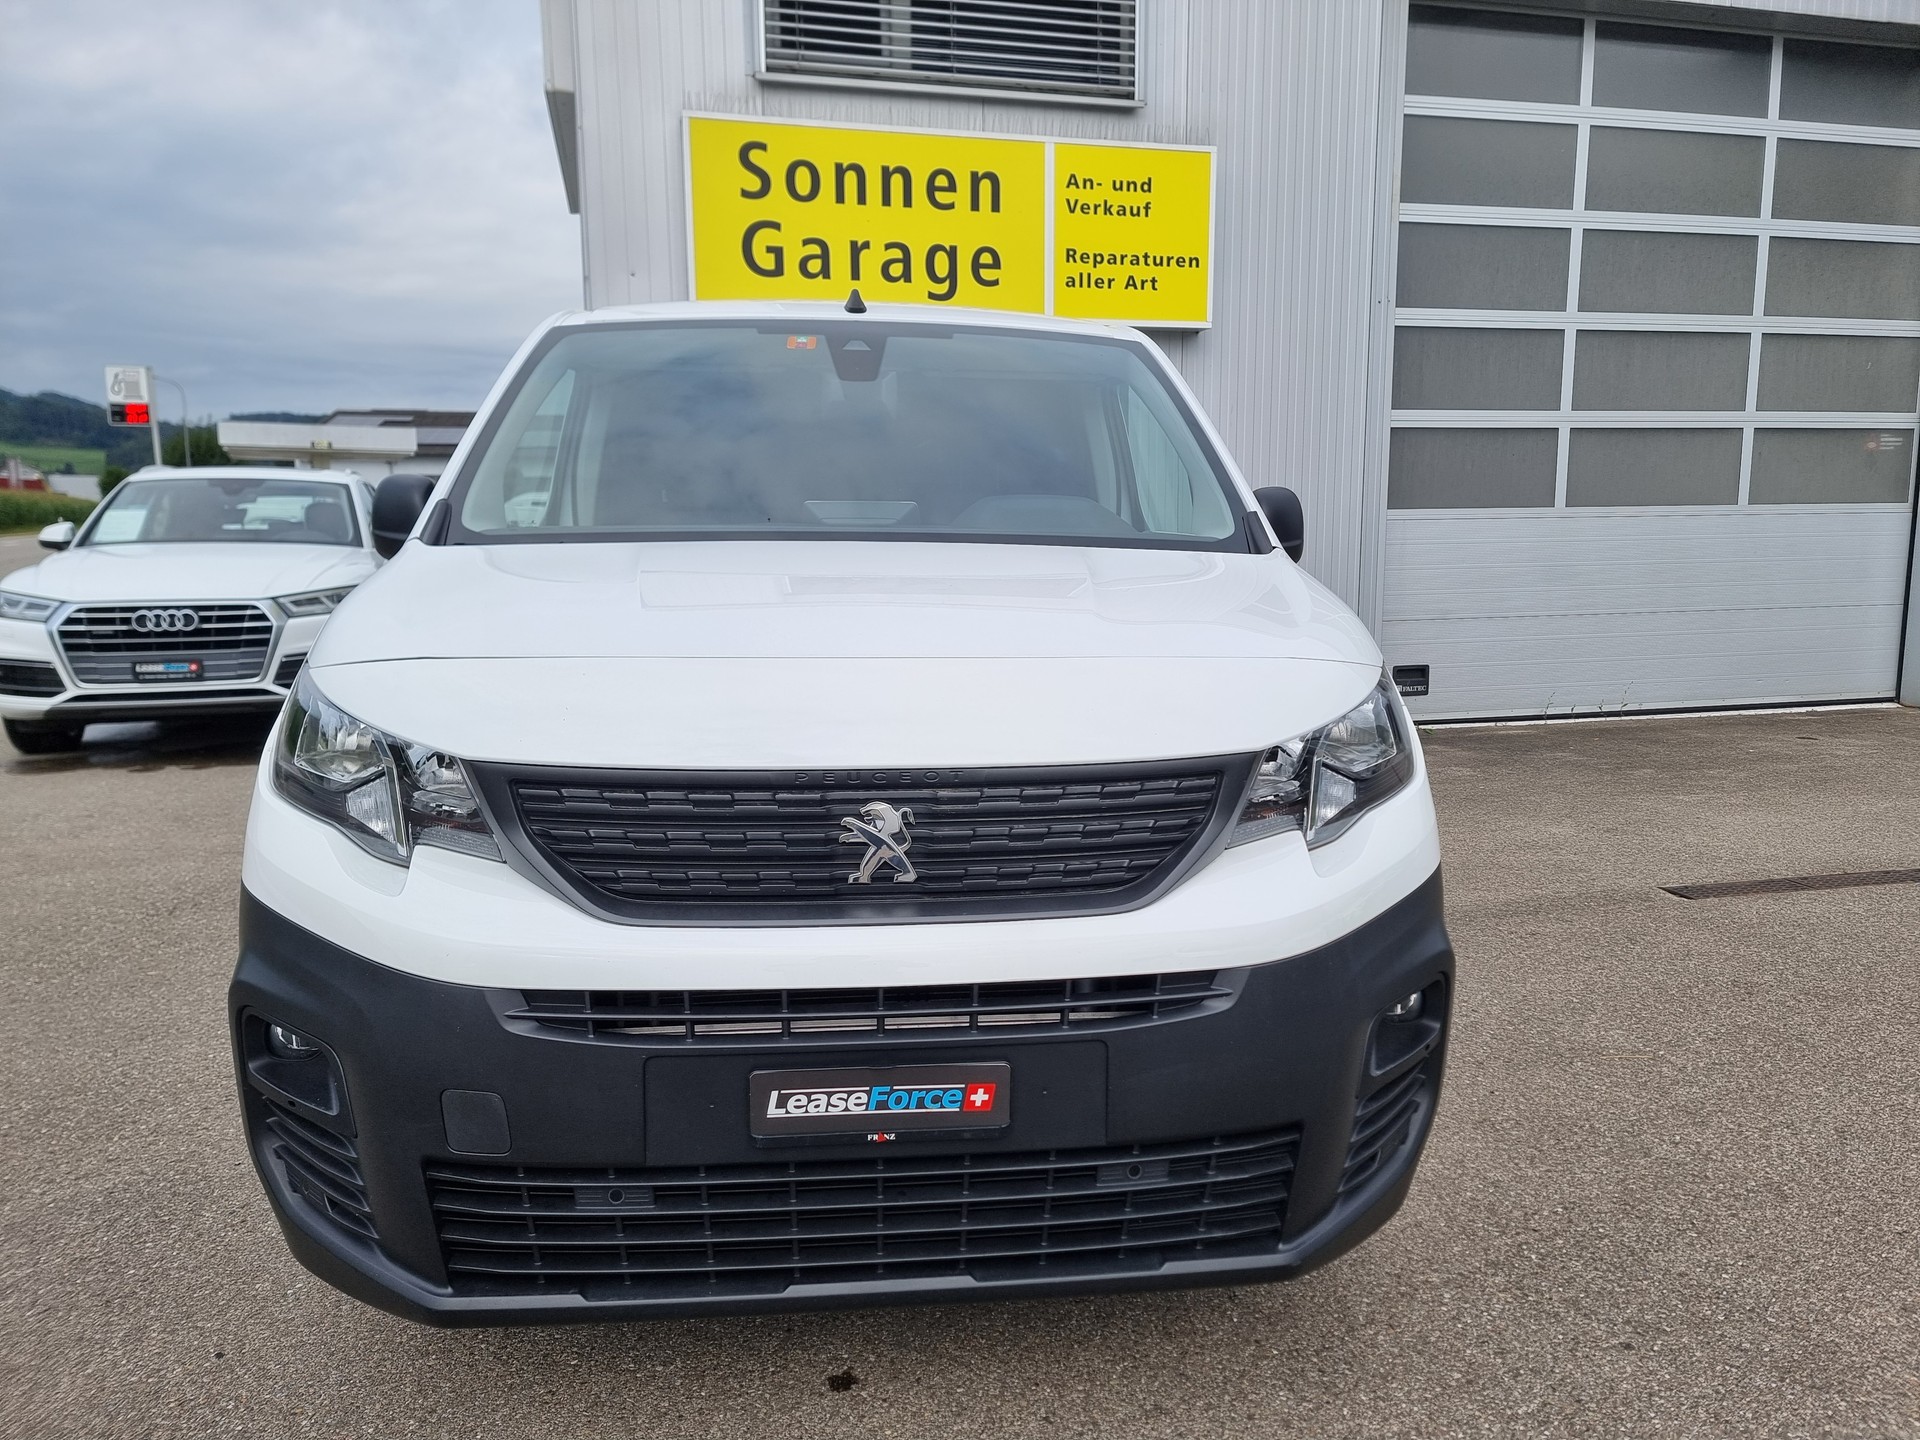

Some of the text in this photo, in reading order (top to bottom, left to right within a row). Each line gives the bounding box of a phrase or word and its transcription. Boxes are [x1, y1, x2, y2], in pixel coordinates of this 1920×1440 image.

[738, 140, 1001, 214] Sonnen
[1065, 173, 1152, 194] An- und
[1065, 197, 1153, 218] Verkauf
[741, 219, 1002, 302] Garage
[1065, 247, 1200, 269] Reparaturen
[1065, 271, 1158, 292] aller Art
[766, 1085, 962, 1116] LeaseForce
